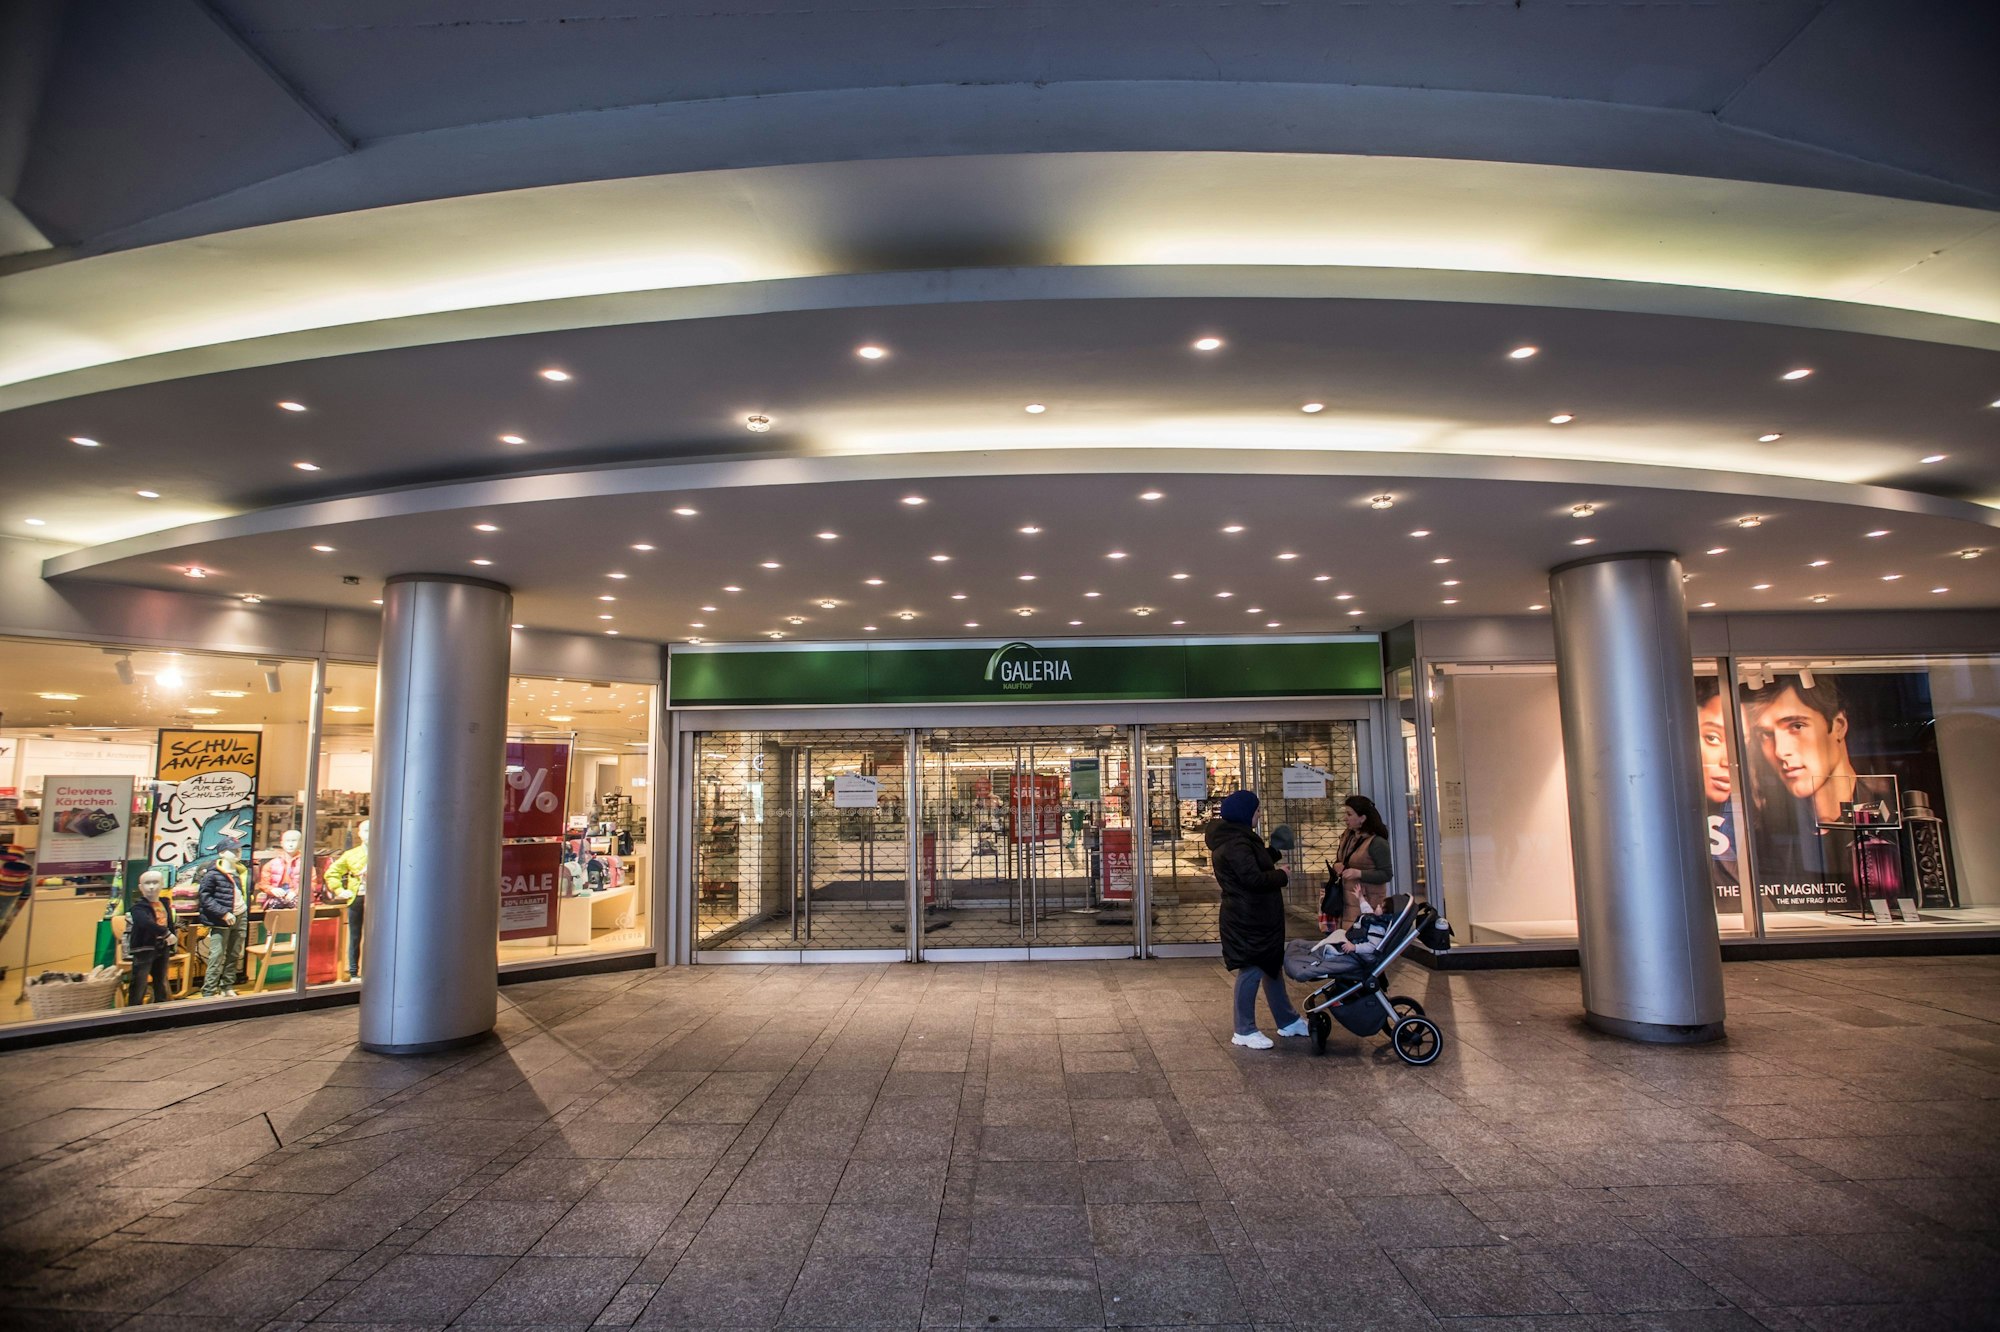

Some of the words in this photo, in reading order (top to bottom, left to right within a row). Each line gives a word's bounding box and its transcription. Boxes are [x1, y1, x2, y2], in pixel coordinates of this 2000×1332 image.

[1001, 660, 1073, 682] GALERIA
[170, 738, 249, 757] SCHUL
[161, 752, 255, 771] ANFANG
[190, 776, 234, 785] ALLES
[56, 786, 113, 796] Cleveres
[181, 791, 247, 800] SCHULSTART
[55, 797, 118, 807] Kärtchen.
[1915, 826, 1940, 889] BOSS
[500, 873, 553, 894] SALE
[1716, 885, 1741, 898] THE
[1790, 897, 1806, 905] NEW
[1806, 896, 1848, 904] FRAGANCES
